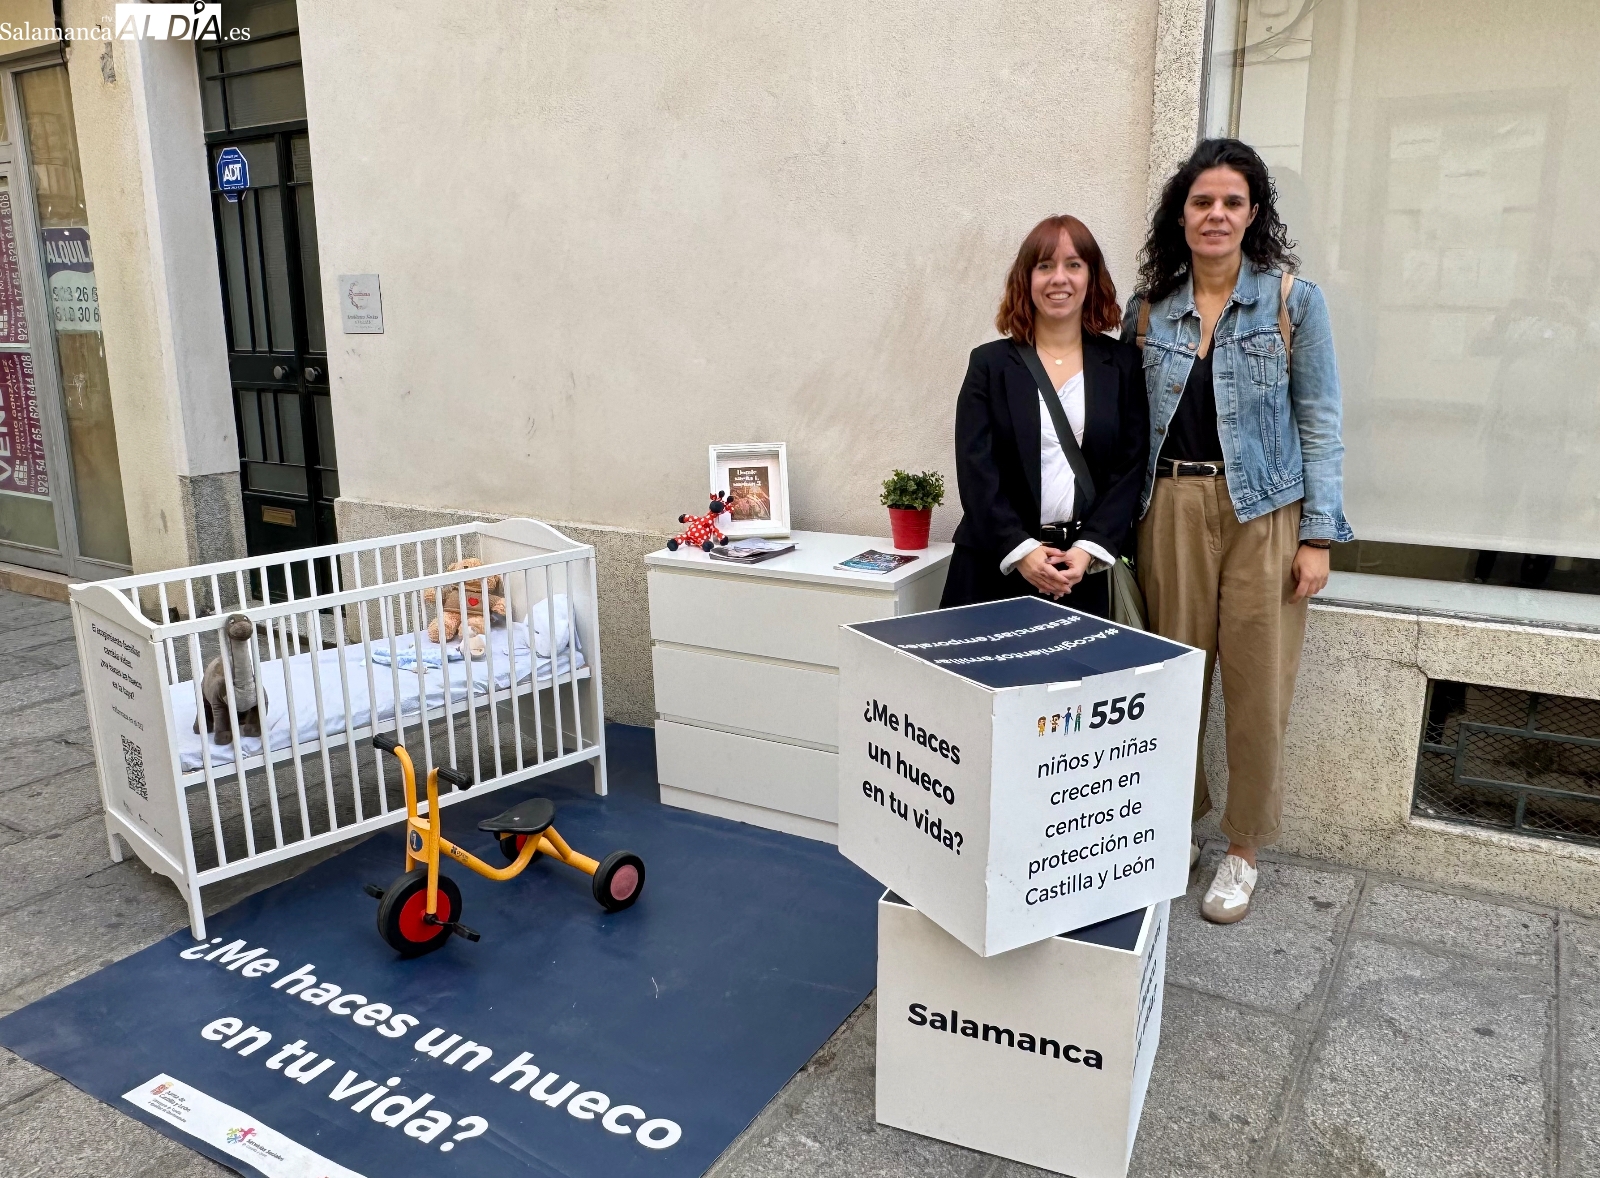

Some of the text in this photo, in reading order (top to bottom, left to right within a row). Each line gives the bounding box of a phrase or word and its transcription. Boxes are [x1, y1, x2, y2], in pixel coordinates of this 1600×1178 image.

[223, 163, 242, 182] ADT
[76, 286, 89, 302] 26
[77, 306, 90, 322] 30
[21, 354, 33, 375] 808
[25, 377, 37, 397] 644
[29, 399, 40, 418] 629
[32, 427, 42, 441] 65
[34, 443, 44, 455] 17
[36, 459, 46, 472] 54
[38, 475, 49, 494] 923
[1089, 692, 1146, 729] 556
[864, 698, 961, 765] ¿Me haces
[868, 741, 955, 805] un hueco
[1037, 735, 1157, 778] niños y niñas
[1050, 768, 1141, 806] crecen en
[862, 779, 964, 855] en tu vida?
[1045, 800, 1142, 838] centros de
[1028, 826, 1155, 879] protección en
[1025, 855, 1155, 906] Castilla y León
[179, 936, 683, 1151] ¿Me haces un hueco
[907, 1002, 1104, 1071] Salamanca
[201, 1015, 490, 1153] en tu vida?
